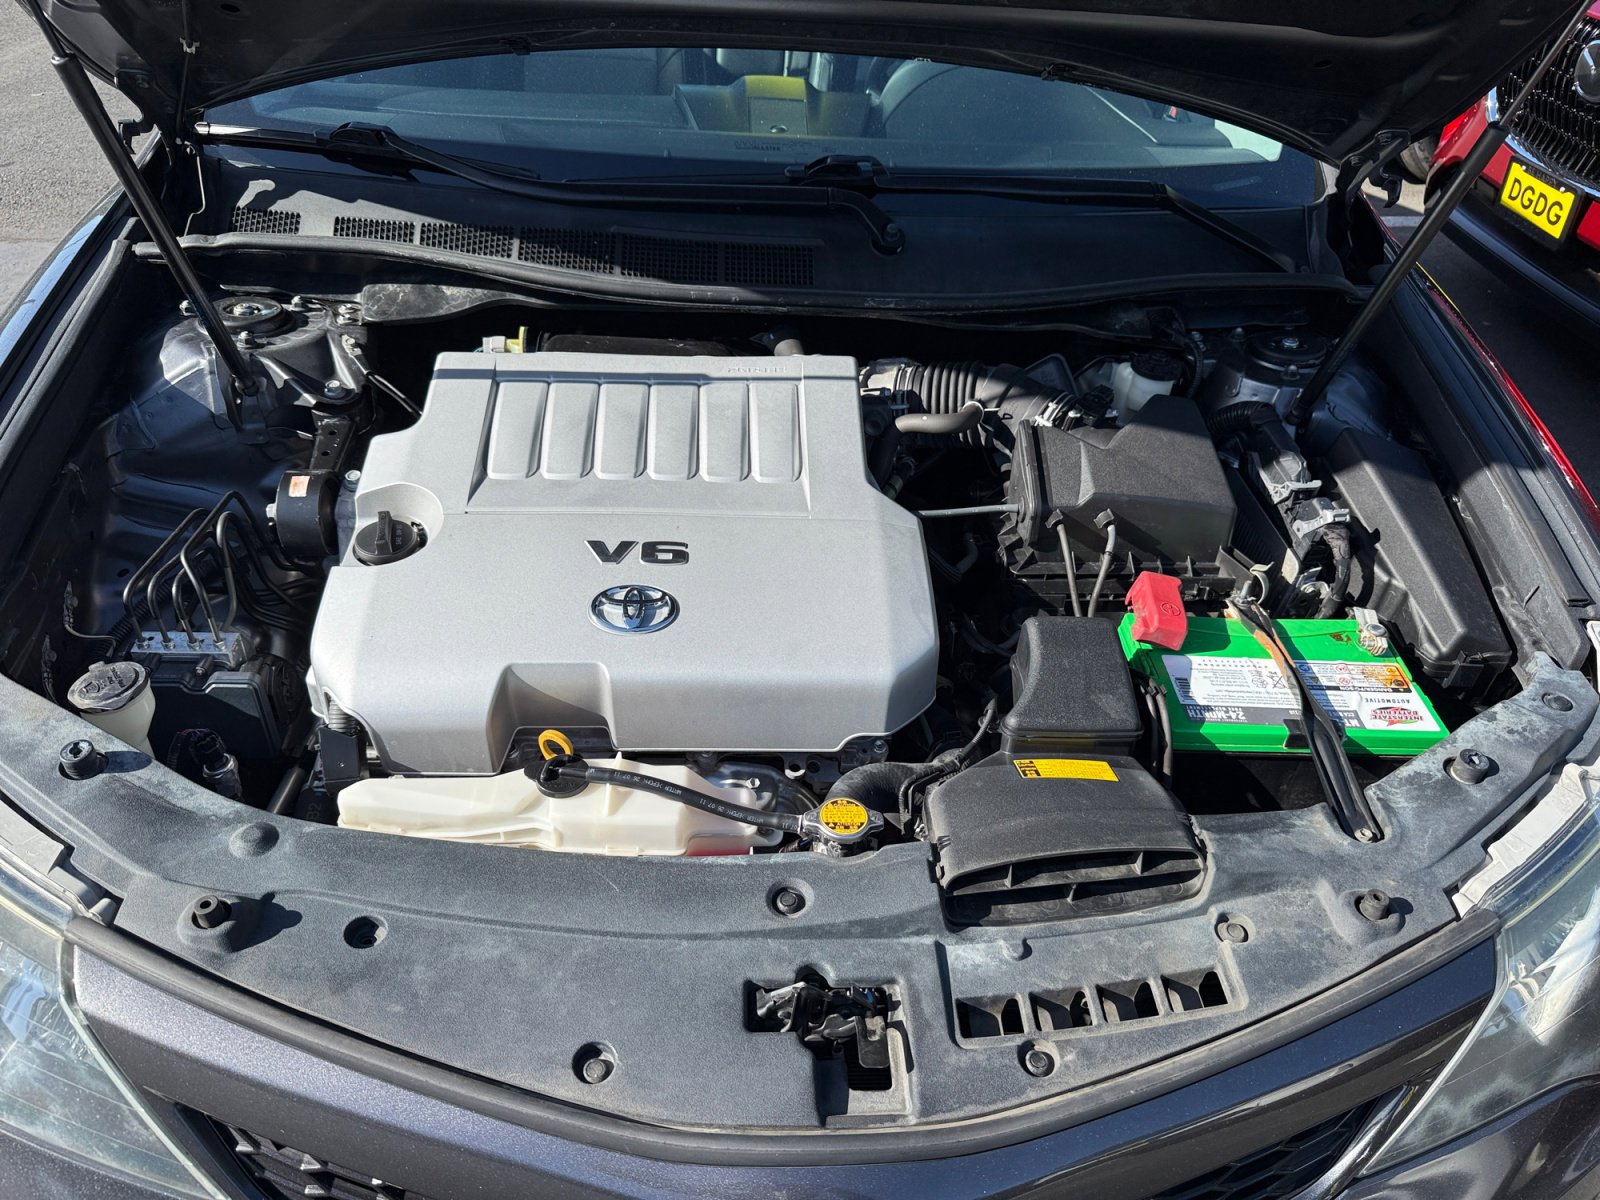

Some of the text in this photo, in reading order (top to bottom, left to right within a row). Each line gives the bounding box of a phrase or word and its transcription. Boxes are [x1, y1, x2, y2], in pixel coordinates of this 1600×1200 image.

[1508, 177, 1563, 226] DGDG
[584, 540, 690, 565] V6
[1187, 709, 1247, 719] 24-MONTH
[664, 785, 682, 795] WATER
[748, 815, 764, 823] WATER
